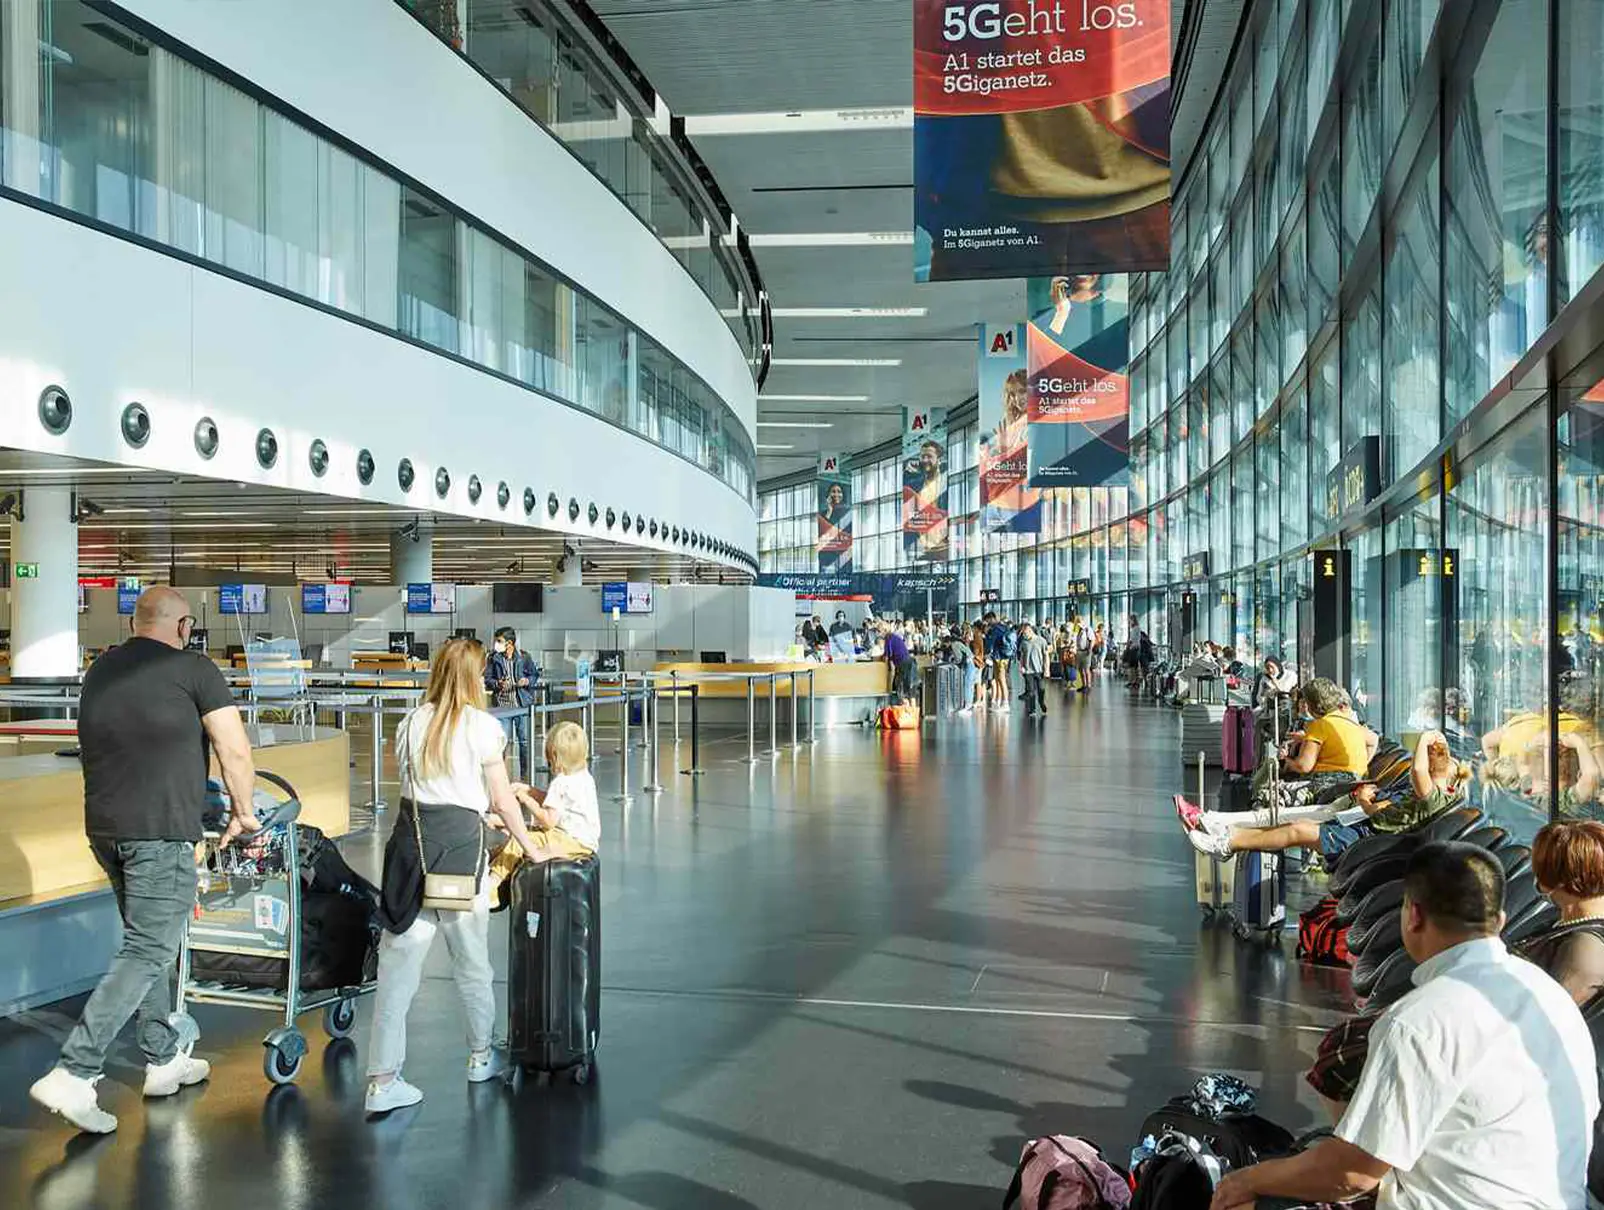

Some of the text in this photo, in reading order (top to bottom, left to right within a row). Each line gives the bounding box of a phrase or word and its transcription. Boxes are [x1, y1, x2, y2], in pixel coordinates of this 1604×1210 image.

[943, 0, 1143, 41] 5Geht los.
[943, 46, 1086, 72] A1 startet das
[943, 72, 1052, 95] 5Giganetz.
[943, 225, 1019, 237] Du kannst alles.
[958, 238, 1005, 250] 5Giganetz
[1006, 237, 1025, 246] von
[990, 330, 1014, 352] A1
[1038, 377, 1089, 394] 5Geht
[911, 413, 928, 431] A1
[824, 456, 837, 471] A1
